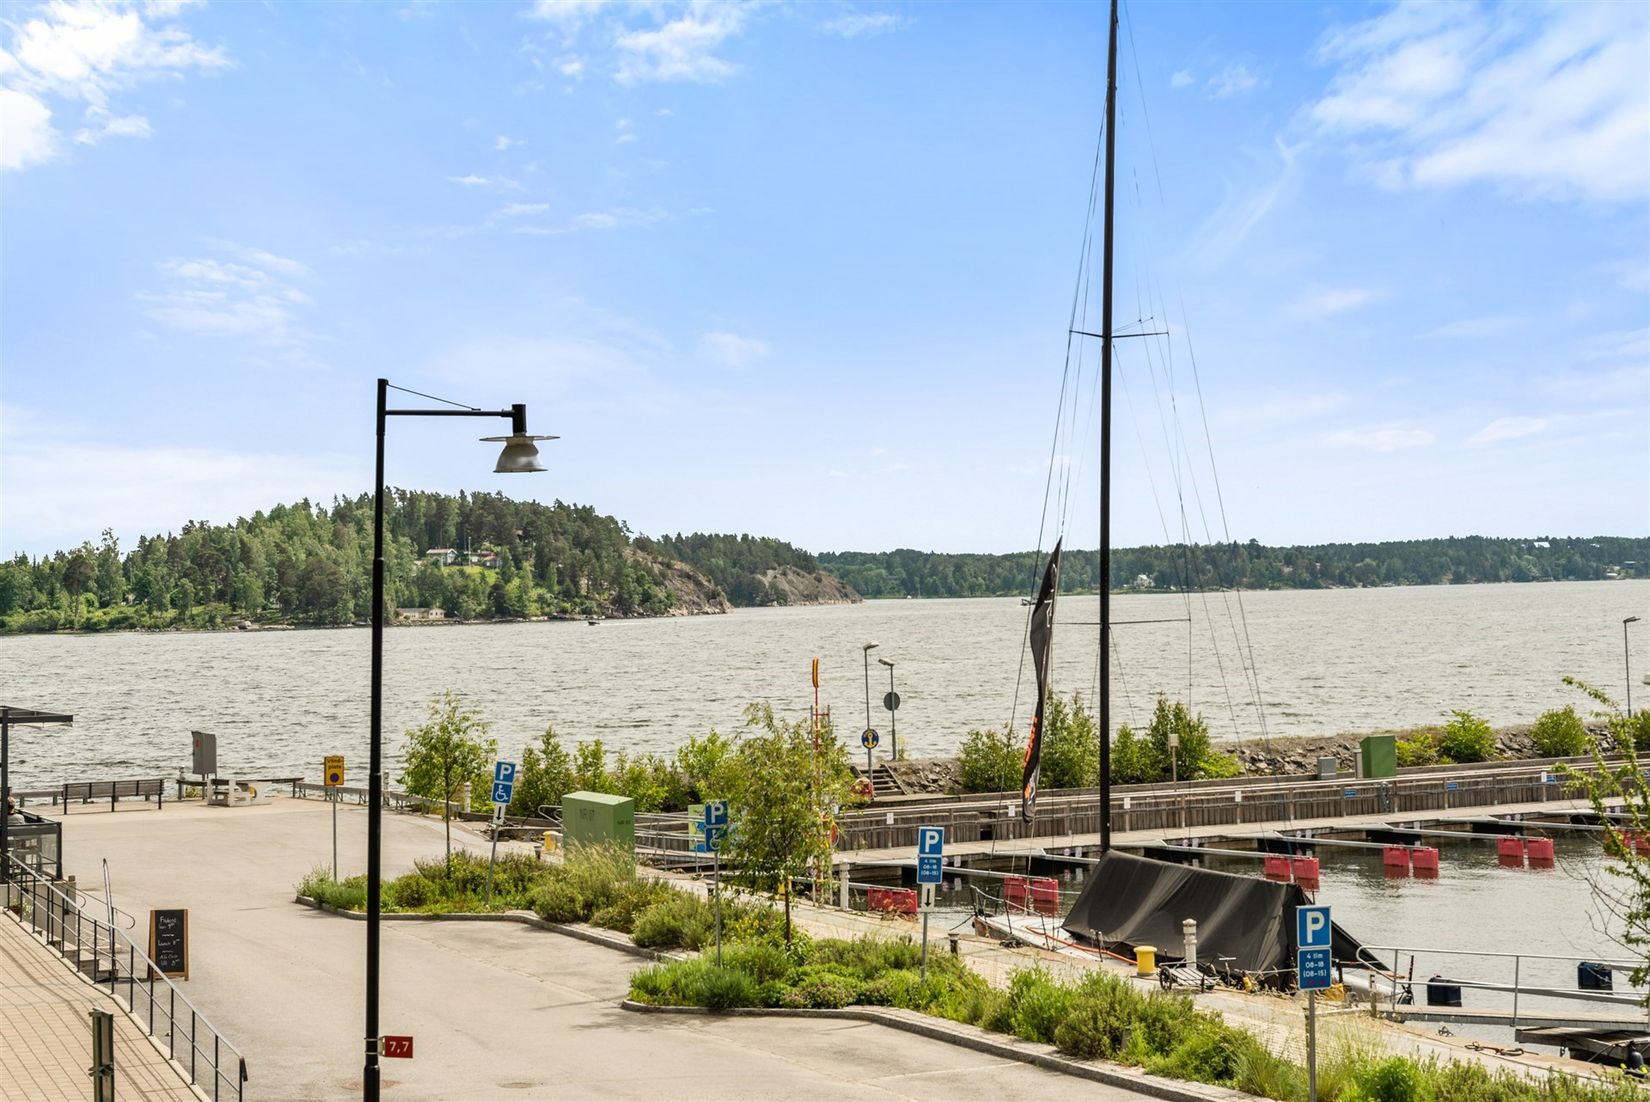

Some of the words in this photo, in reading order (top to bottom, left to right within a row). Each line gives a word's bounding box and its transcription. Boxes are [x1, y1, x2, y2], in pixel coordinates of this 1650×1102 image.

[499, 764, 512, 780] P
[711, 804, 724, 823] P
[925, 831, 939, 853] P
[1306, 911, 1325, 943] P
[1303, 969, 1326, 978] (08-15)
[389, 1041, 409, 1054] 7,7
